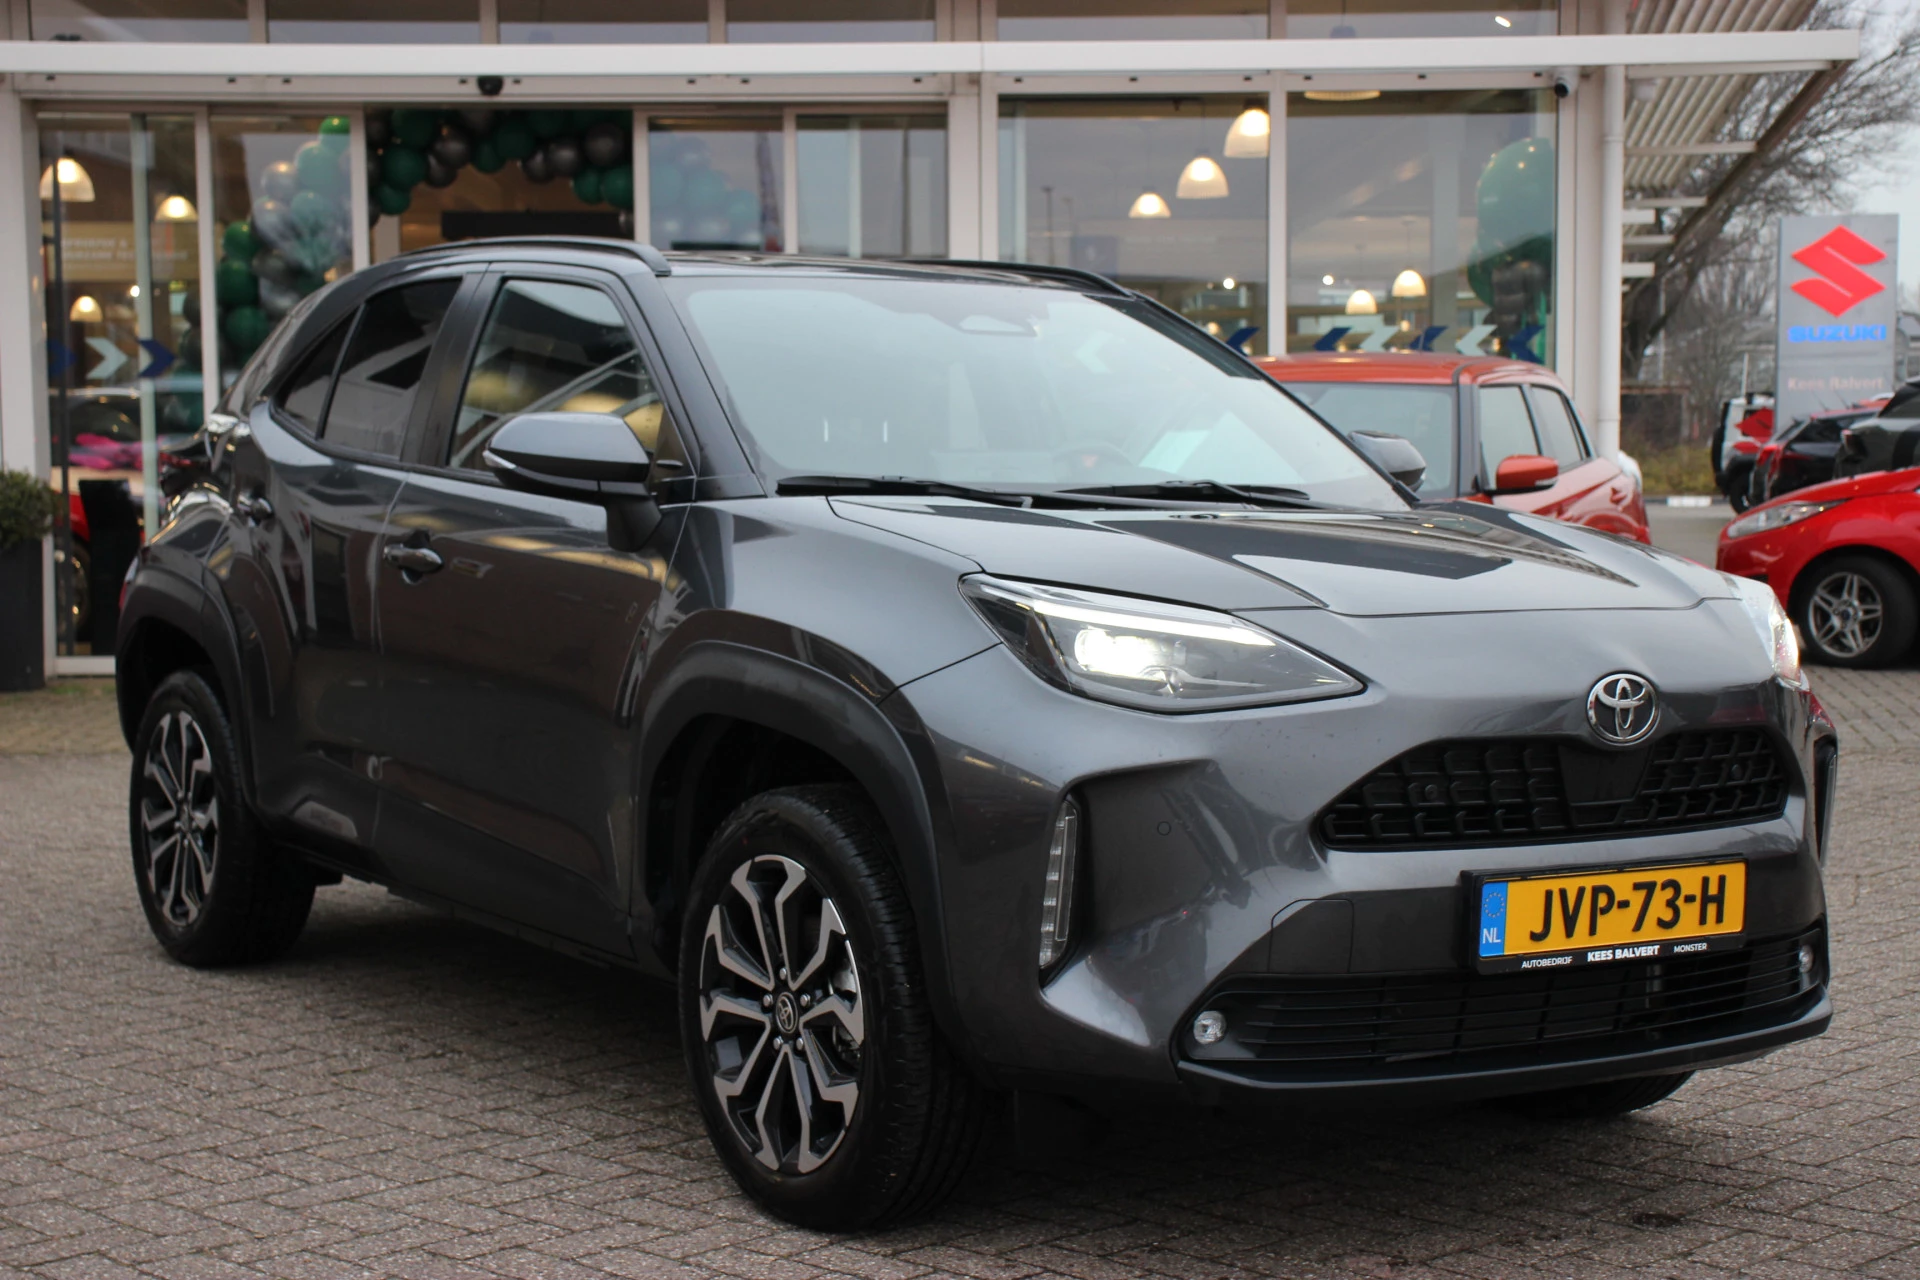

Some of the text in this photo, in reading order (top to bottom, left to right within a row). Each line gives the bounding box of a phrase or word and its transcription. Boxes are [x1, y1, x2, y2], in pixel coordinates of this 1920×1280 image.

[1788, 325, 1887, 342] SUZUKI
[1529, 875, 1727, 942] JVP-73-H
[1482, 928, 1501, 944] NL
[1521, 942, 1707, 969] AUTOBEDRIJF KEES BALVERT MONSTER
